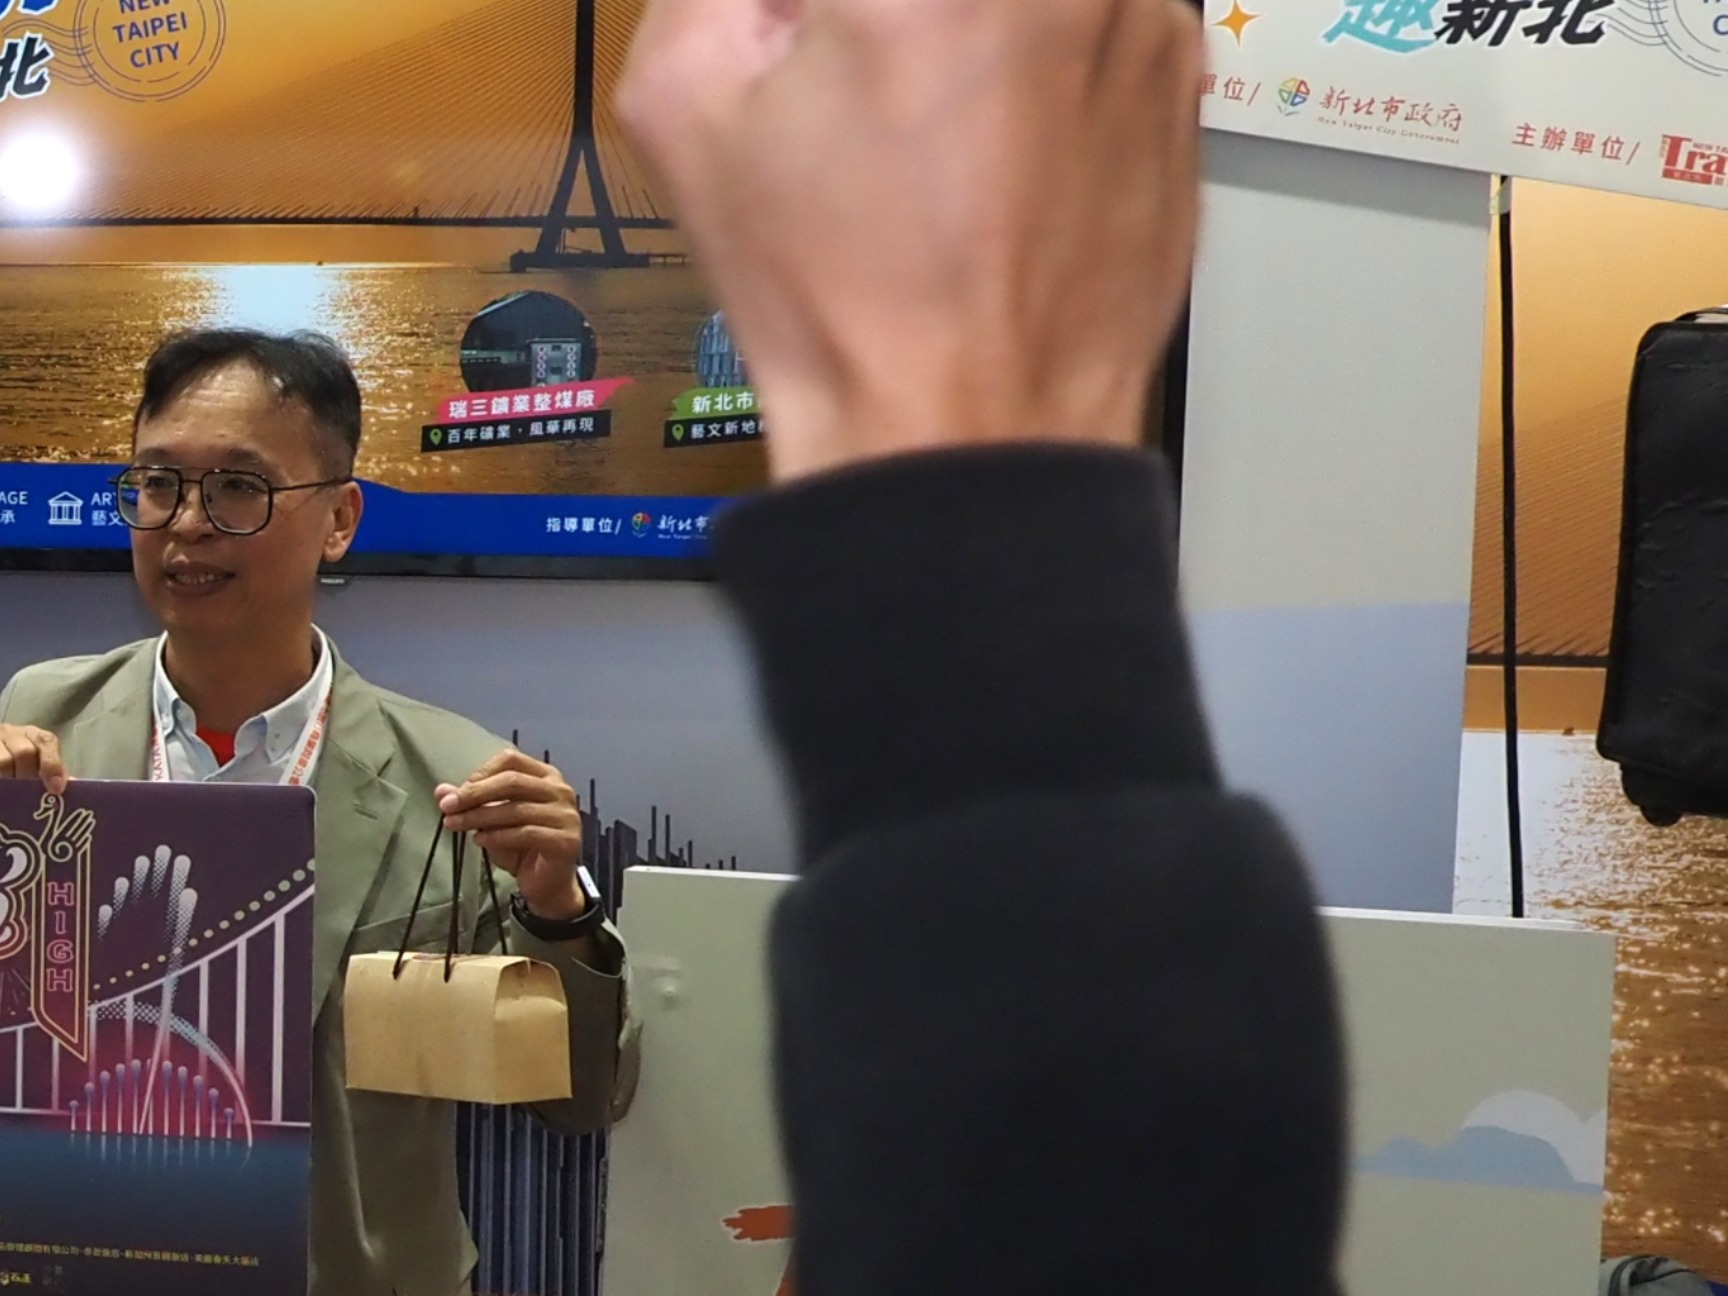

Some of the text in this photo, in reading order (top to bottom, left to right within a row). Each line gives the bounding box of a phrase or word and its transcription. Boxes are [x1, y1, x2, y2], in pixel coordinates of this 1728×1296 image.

[112, 10, 189, 44] TAIPEI
[130, 40, 181, 70] CITY
[691, 391, 760, 414] 新北市
[90, 492, 118, 506] AR
[45, 881, 76, 993] HIGH
